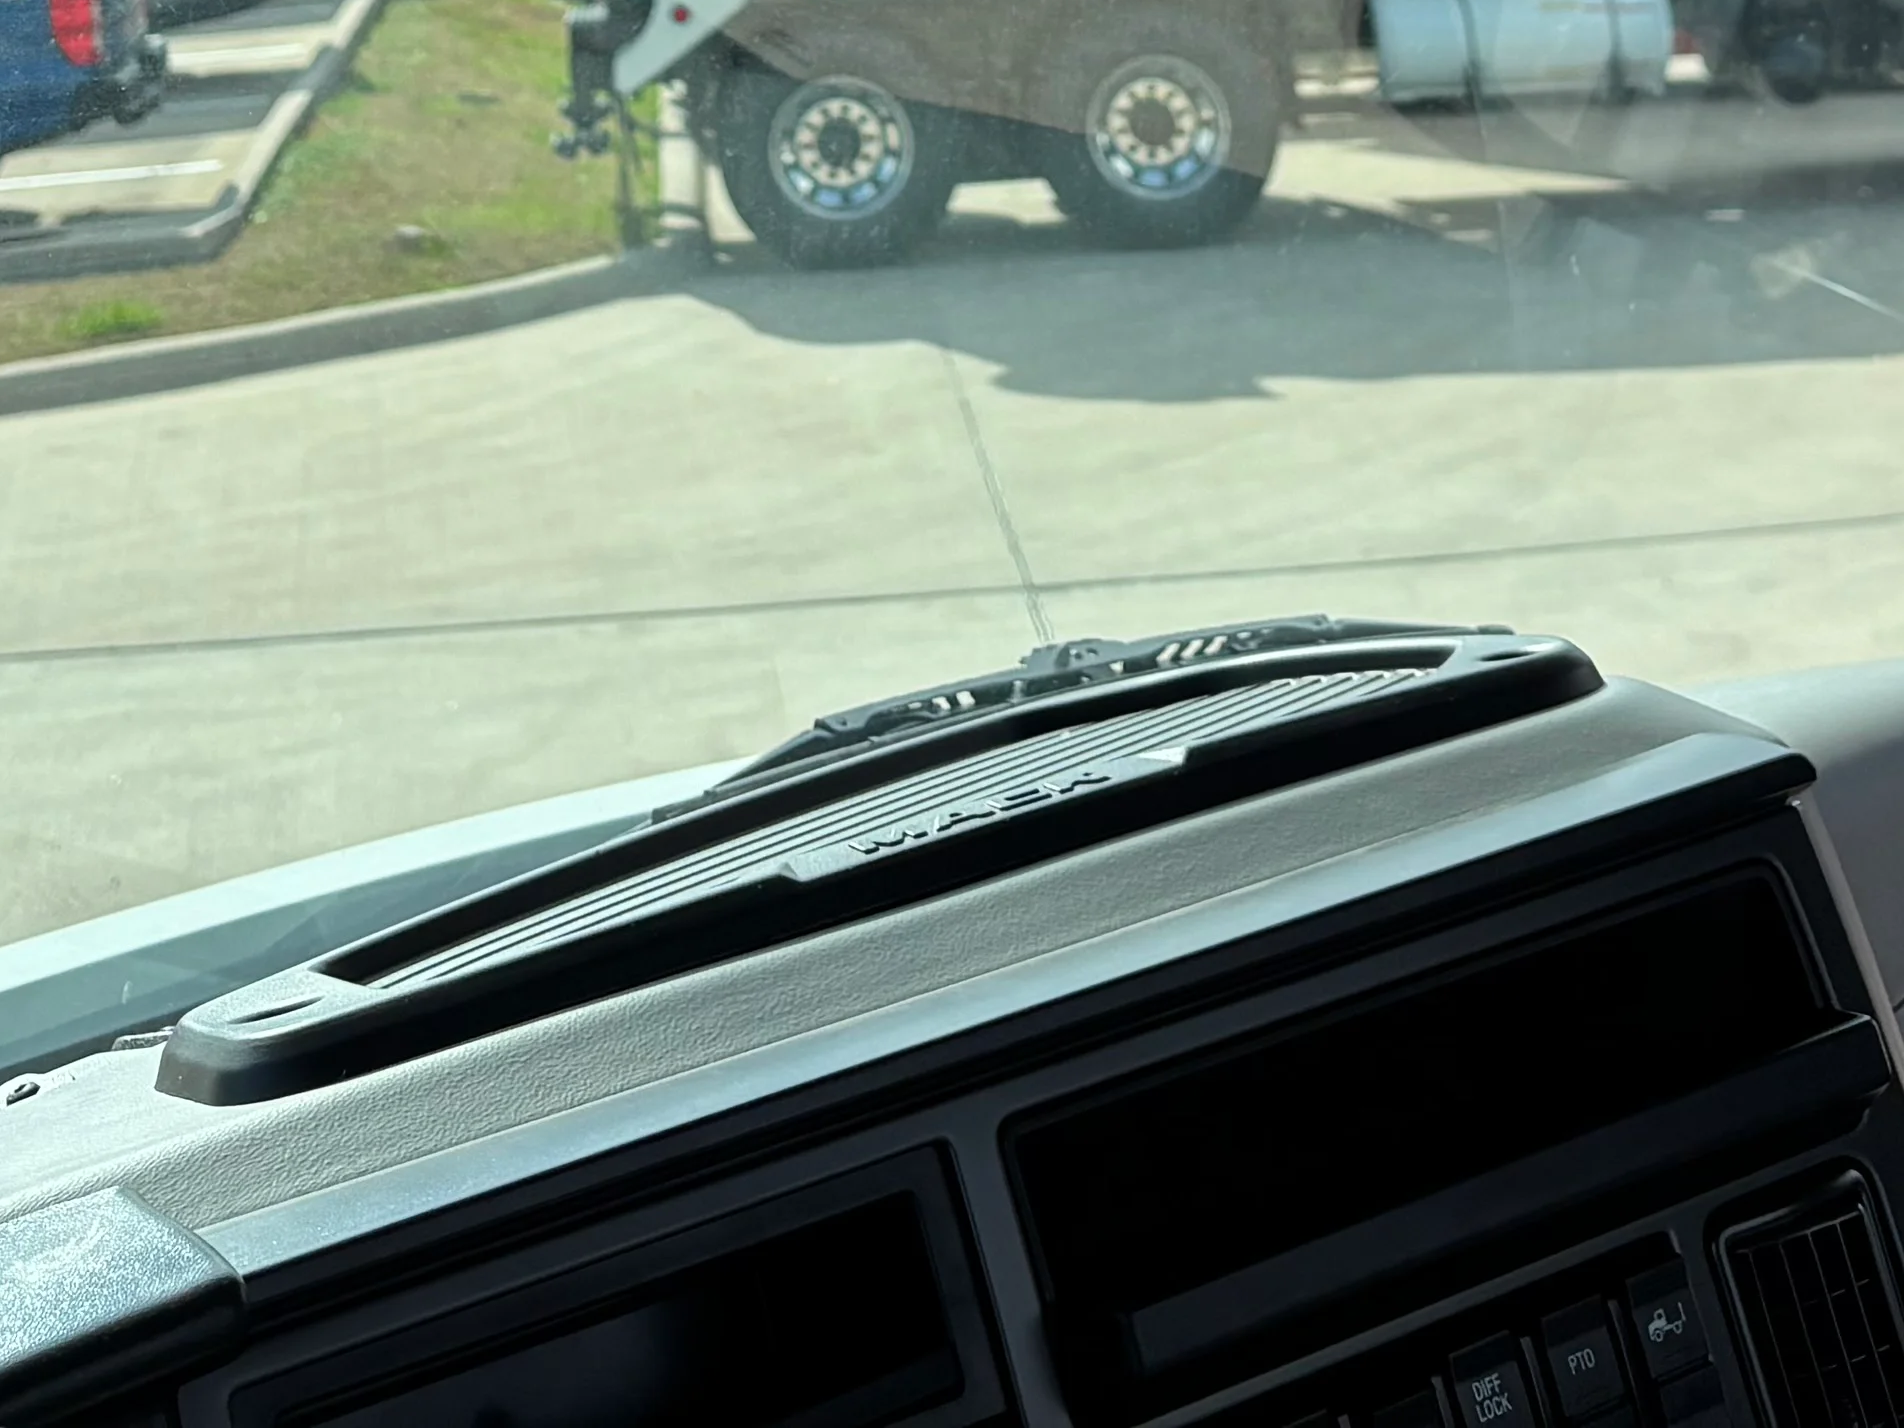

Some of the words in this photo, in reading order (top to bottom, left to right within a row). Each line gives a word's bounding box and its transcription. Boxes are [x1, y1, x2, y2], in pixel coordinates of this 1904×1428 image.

[848, 771, 1112, 855] MACK
[1567, 1347, 1596, 1375] PTO
[1471, 1372, 1503, 1403] DIFF
[1475, 1393, 1513, 1424] LOCK
